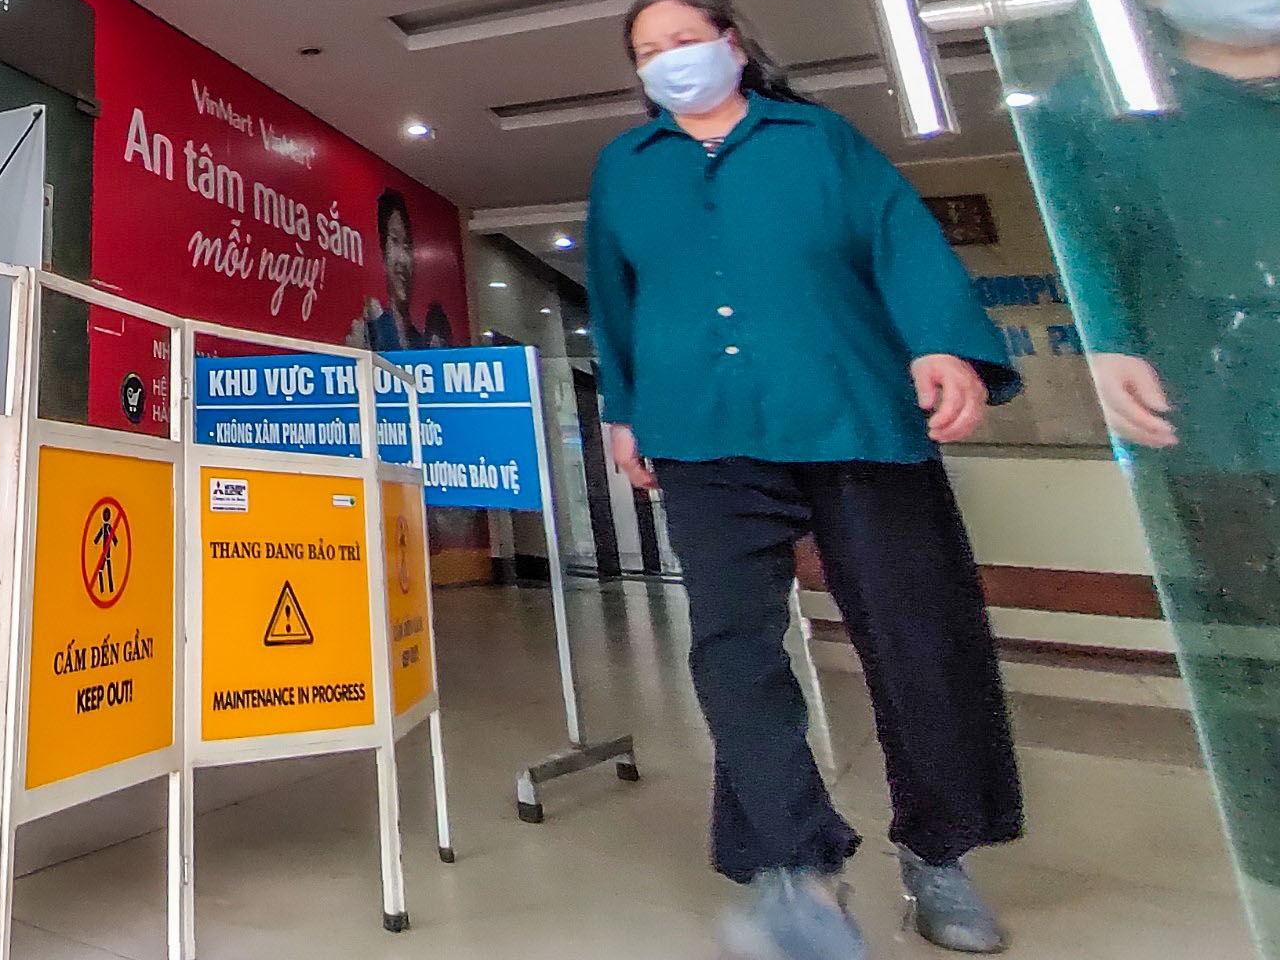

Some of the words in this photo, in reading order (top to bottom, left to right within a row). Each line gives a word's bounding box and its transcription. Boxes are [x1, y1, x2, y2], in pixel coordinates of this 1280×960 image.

[192, 78, 254, 138] VinMart
[124, 108, 174, 181] An
[183, 140, 244, 214] tâm
[253, 182, 311, 241] mua
[316, 200, 364, 267] sắm
[188, 219, 254, 279] mỗi
[258, 242, 327, 322] ngày!
[209, 369, 257, 397] KHU
[264, 365, 314, 401] VỰC
[443, 361, 505, 398] MẠI
[216, 418, 253, 444] KHÔNG
[255, 418, 280, 444] XÂM
[282, 422, 316, 449] PHẠM
[318, 417, 346, 445] DƯỚI
[422, 460, 468, 492] LƯỢNG
[468, 456, 498, 489] BẢO
[500, 460, 520, 495] VỆ
[210, 541, 261, 559] THANG
[265, 542, 305, 559] ĐANG
[308, 538, 336, 560] BẢO
[338, 541, 361, 562] TRÌ
[53, 638, 87, 675] CẤM
[90, 633, 120, 669] ĐẾN
[123, 628, 153, 662] GẦN!
[76, 684, 104, 714] KEEP
[107, 678, 133, 706] OUT!
[213, 688, 295, 711] MAINTENANCE
[297, 687, 309, 705] IN
[312, 683, 365, 704] PROGRESS
